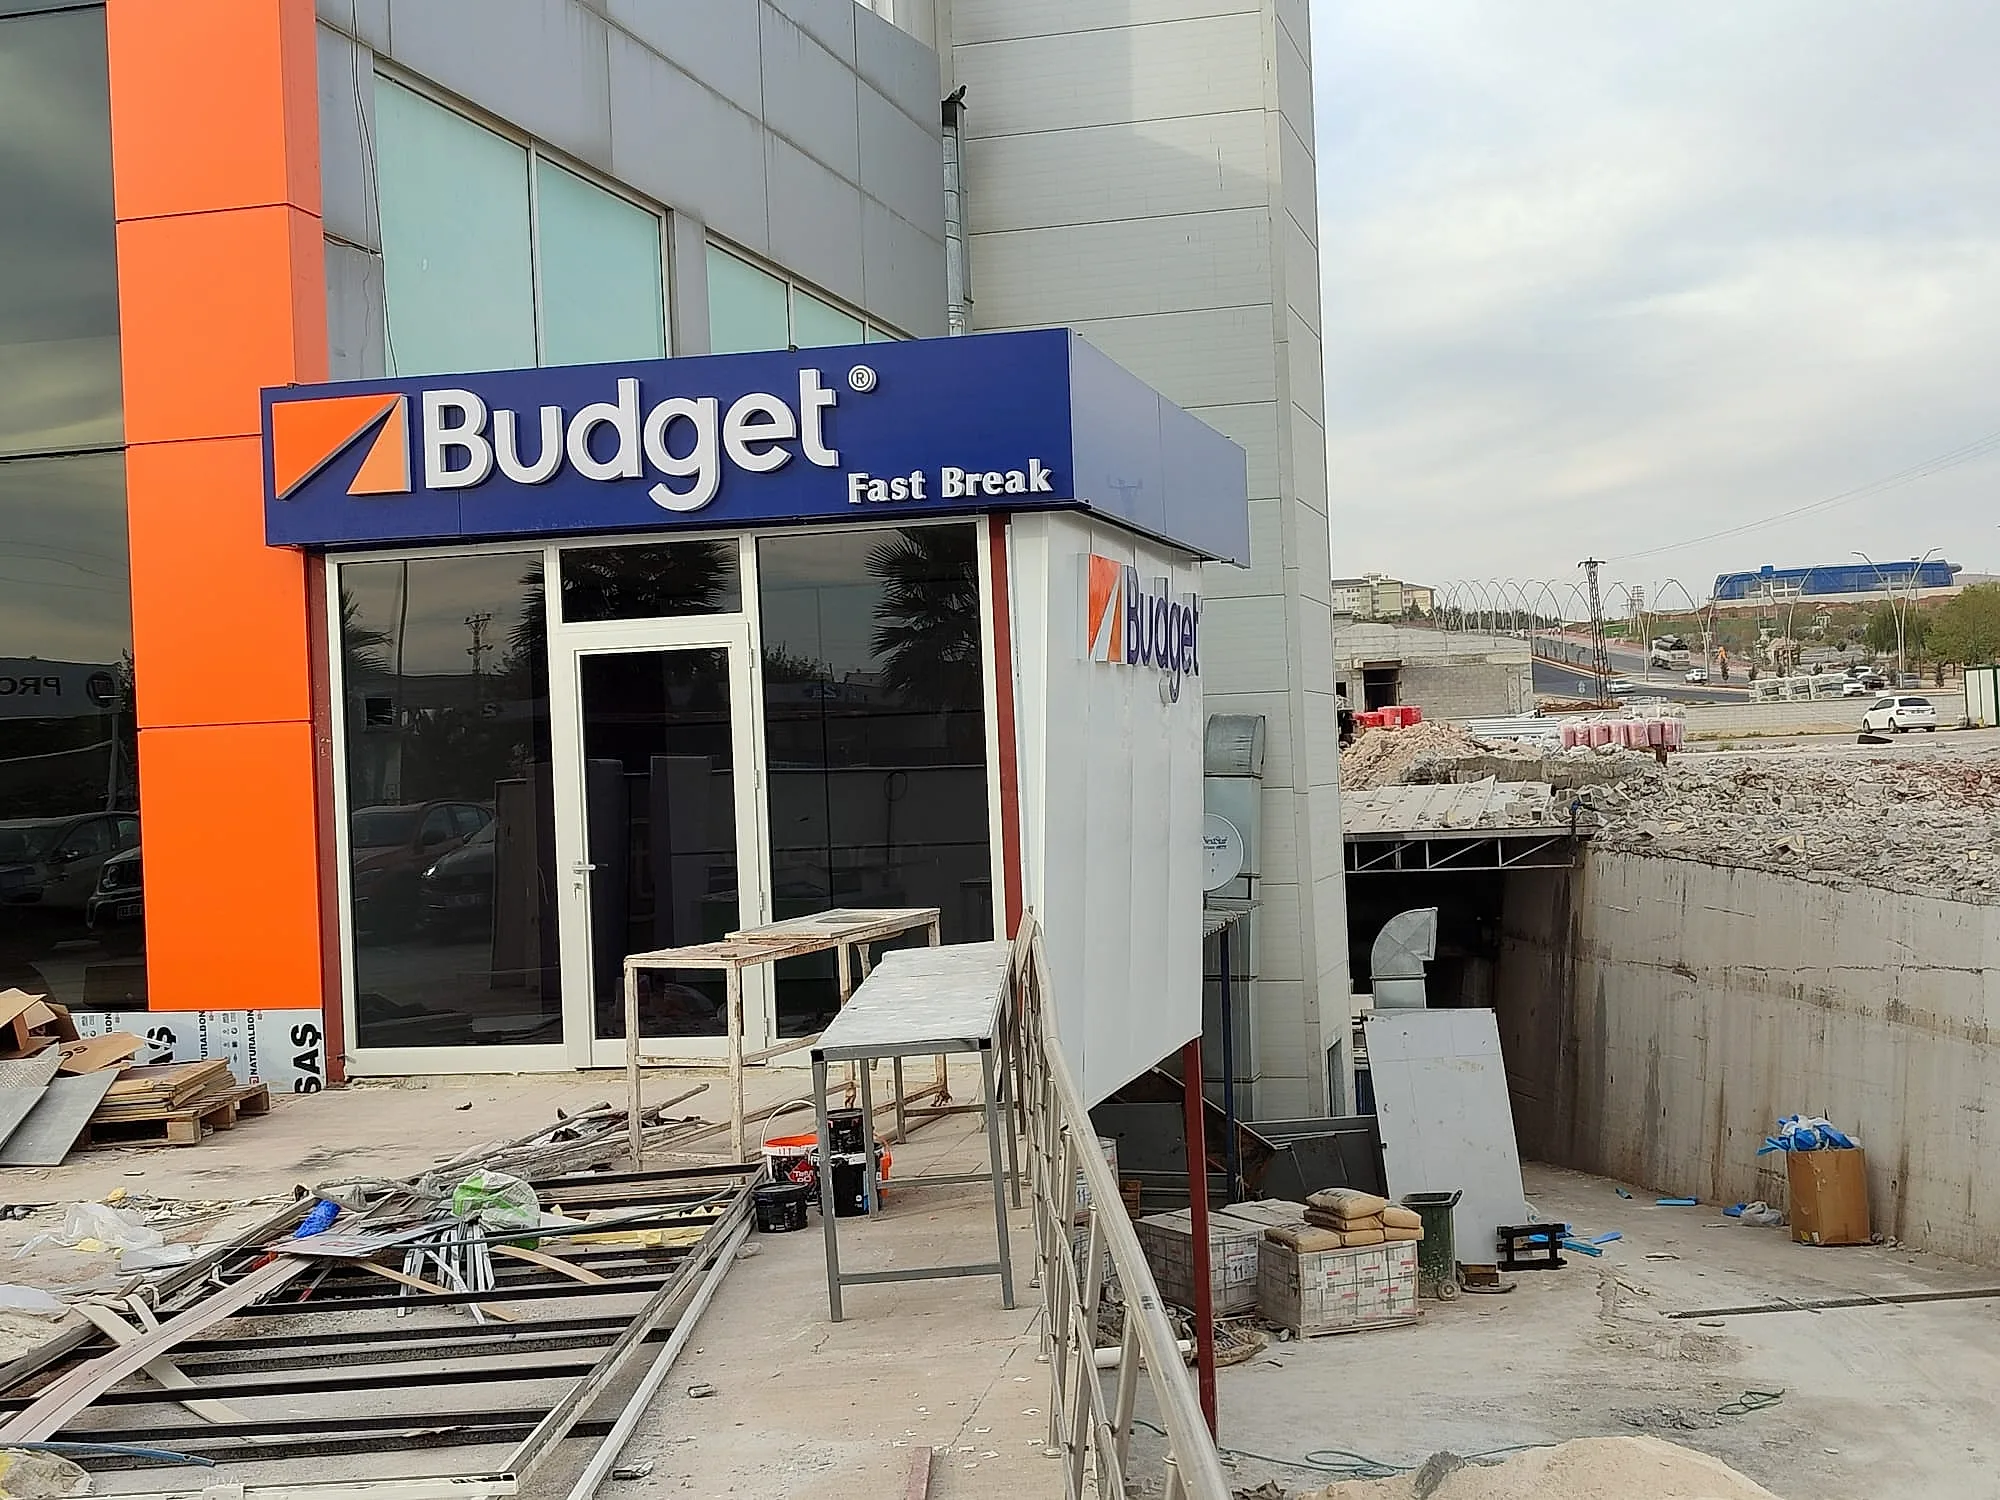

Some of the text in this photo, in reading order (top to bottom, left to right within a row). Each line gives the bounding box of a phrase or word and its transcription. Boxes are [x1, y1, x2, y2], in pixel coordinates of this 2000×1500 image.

[422, 368, 839, 512] Budget
[848, 458, 1053, 503] Fast Break
[1127, 565, 1199, 703] Budget
